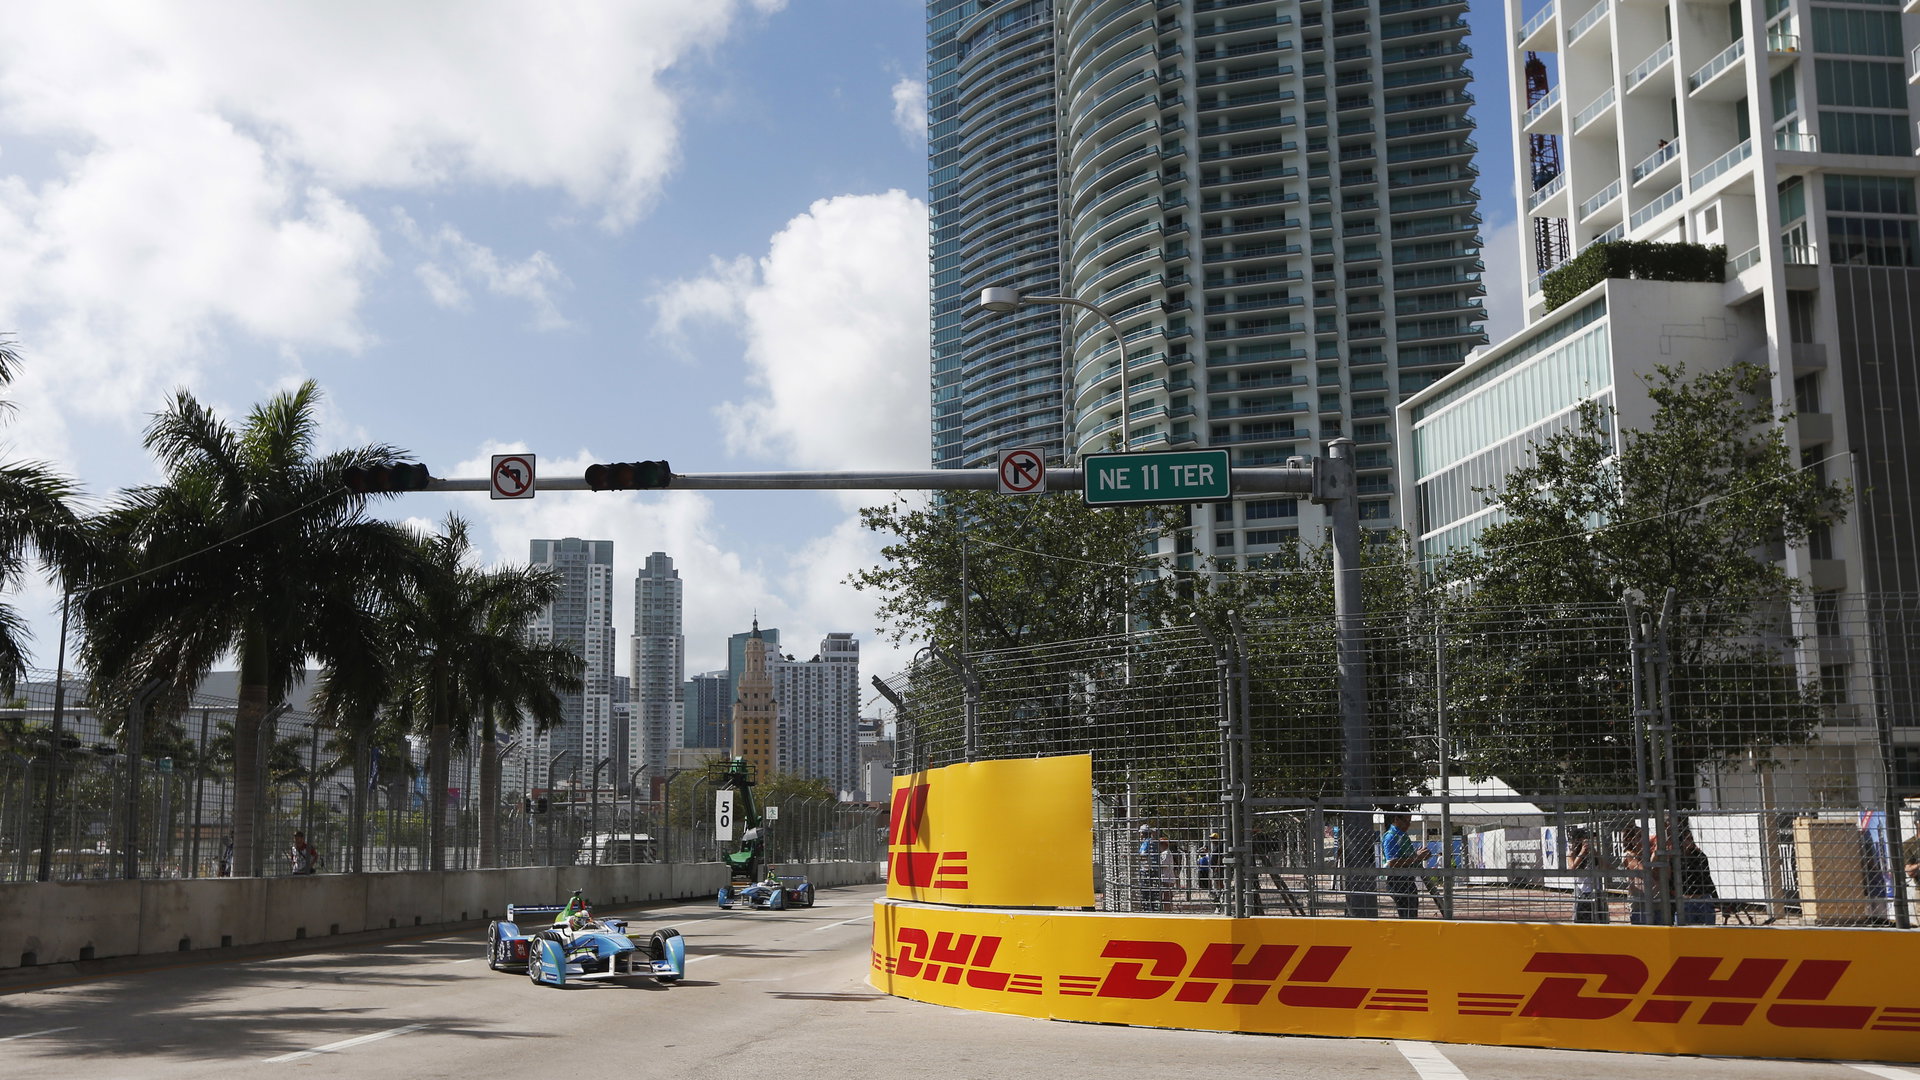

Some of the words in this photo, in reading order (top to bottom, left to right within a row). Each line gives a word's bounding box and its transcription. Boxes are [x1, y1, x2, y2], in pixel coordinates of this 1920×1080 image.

[1099, 467, 1131, 490] NE
[1141, 464, 1159, 490] 11
[1169, 463, 1215, 487] TER
[720, 801, 730, 828] 50
[895, 927, 1011, 992] DHL
[1097, 939, 1371, 1009] DHL
[1518, 952, 1877, 1030] DHL
